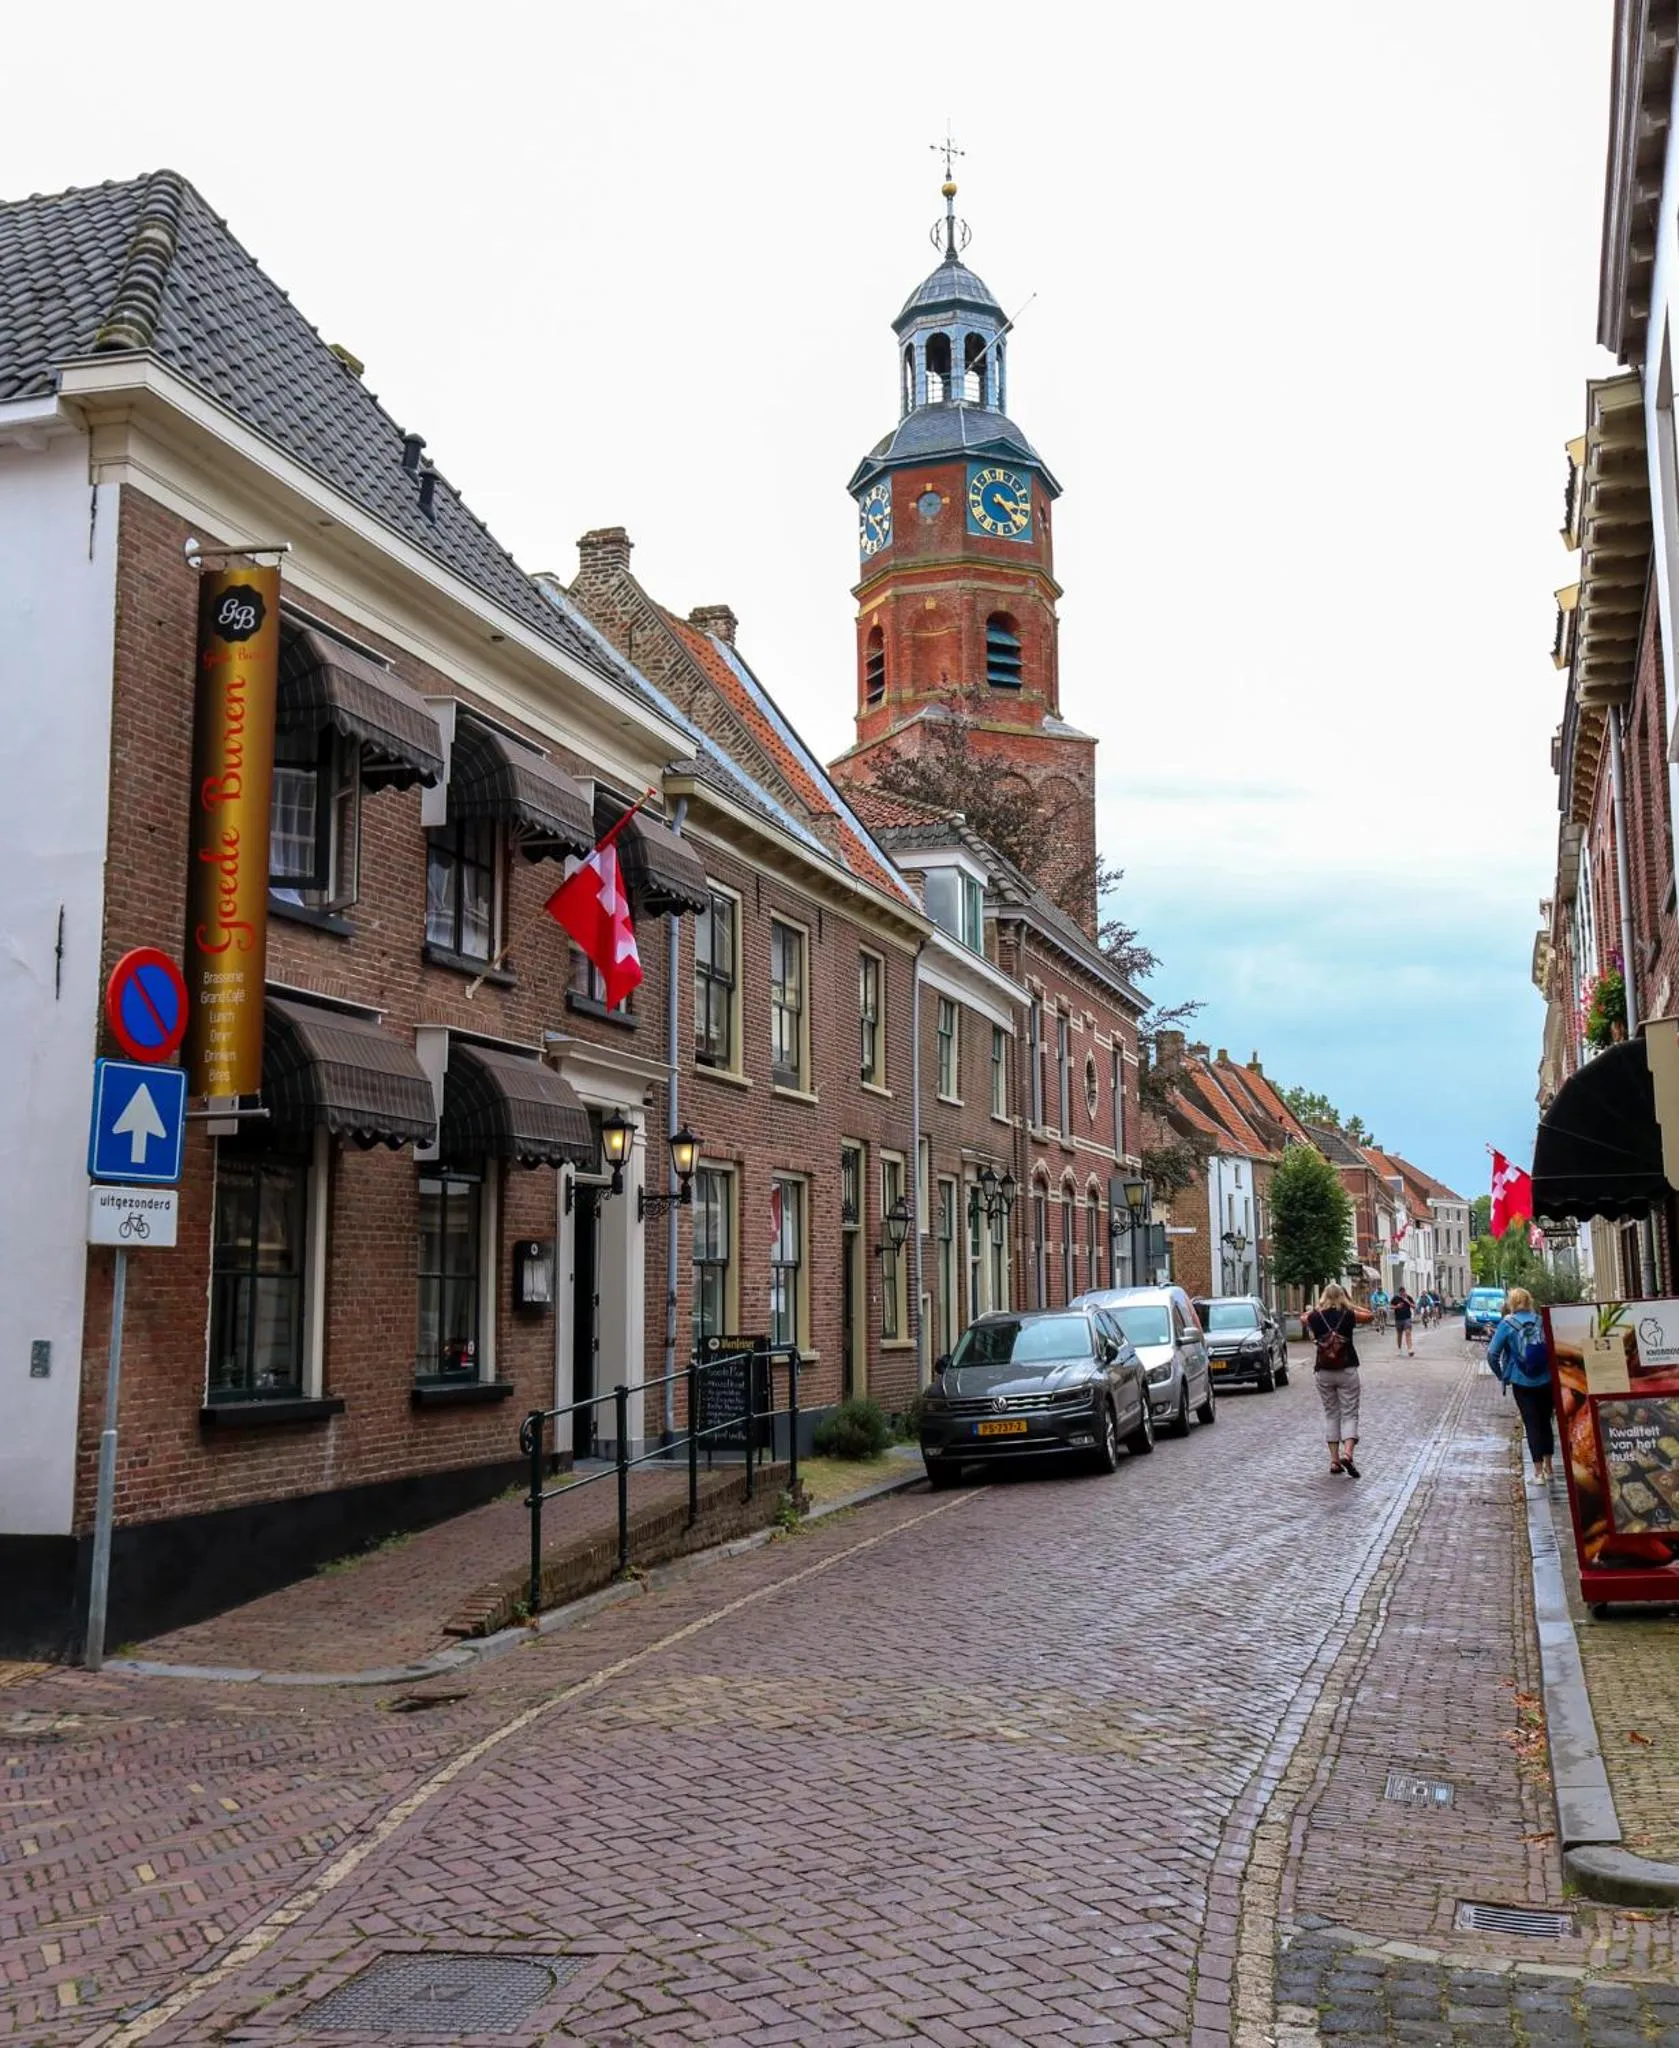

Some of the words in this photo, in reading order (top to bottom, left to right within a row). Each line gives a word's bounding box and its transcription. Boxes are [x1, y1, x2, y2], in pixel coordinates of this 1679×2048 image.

[200, 675, 248, 814] Buren
[195, 827, 256, 954] Goede
[100, 1195, 171, 1210] uitgezonderd
[1609, 1426, 1660, 1437] Kwaliteit
[1611, 1441, 1633, 1450] van
[1636, 1438, 1657, 1449] het
